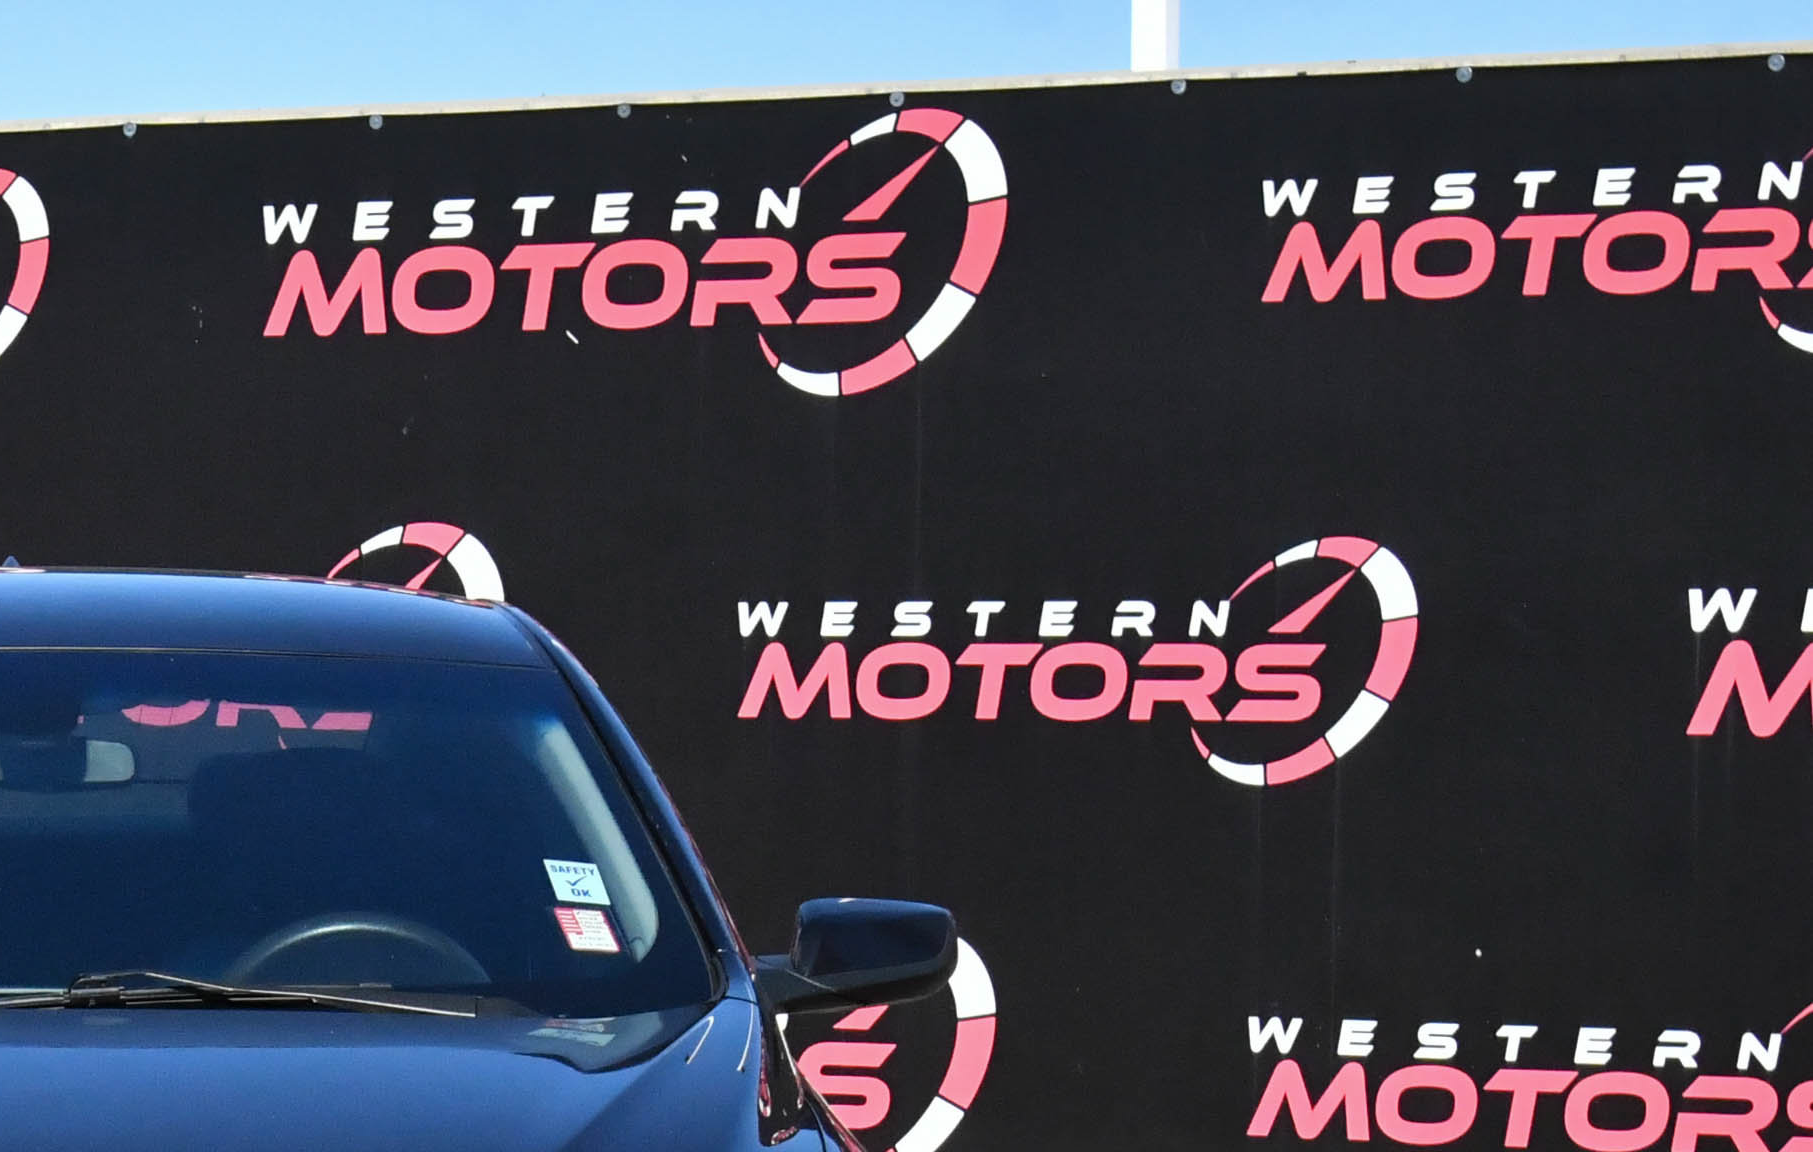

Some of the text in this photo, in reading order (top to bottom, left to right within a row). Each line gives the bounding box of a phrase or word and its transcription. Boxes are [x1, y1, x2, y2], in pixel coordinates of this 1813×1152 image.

[262, 186, 802, 245] WESTERN
[1262, 160, 1805, 218] WESTERN
[1261, 206, 1813, 303] MOTOR
[262, 231, 907, 337] MOTORS
[737, 599, 1231, 639] WESTERN
[737, 641, 1327, 723] MOTORS
[549, 865, 595, 876] SAFETY
[570, 887, 593, 898] OK
[1246, 1015, 1783, 1072] WESTERN
